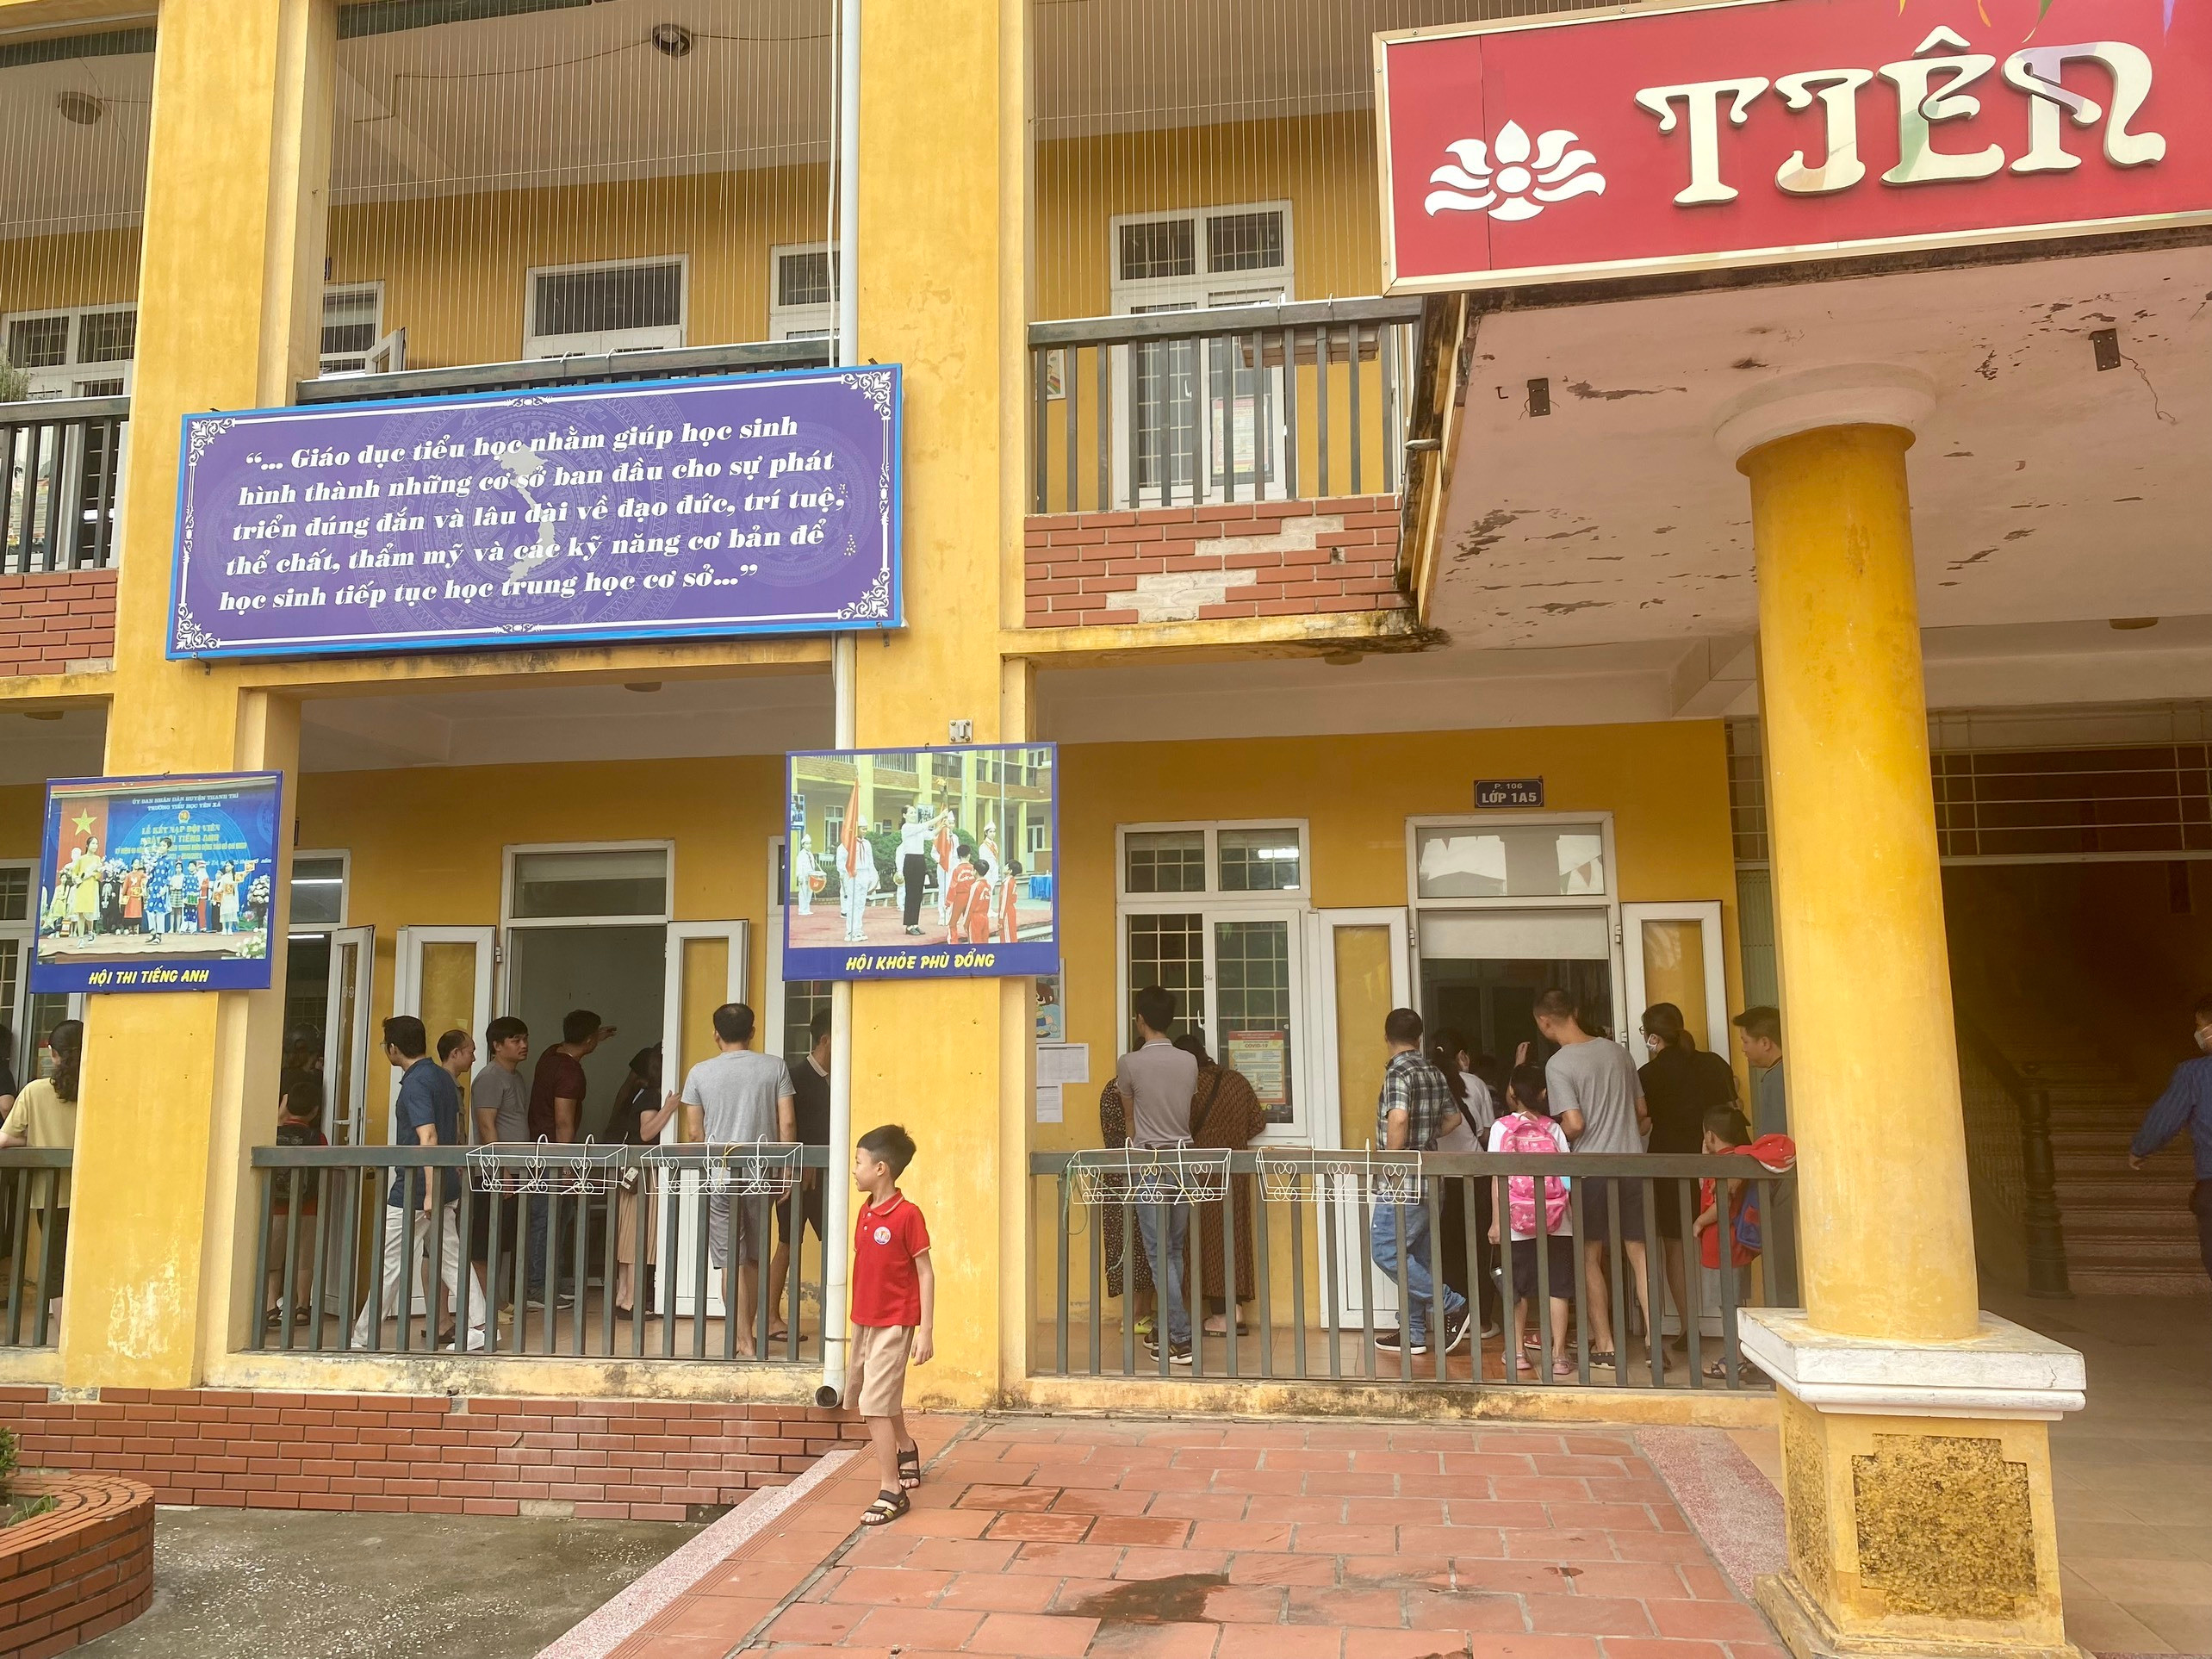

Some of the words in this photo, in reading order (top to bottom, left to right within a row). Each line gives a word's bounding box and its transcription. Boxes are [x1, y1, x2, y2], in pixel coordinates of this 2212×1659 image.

[291, 446, 351, 469] Giáo
[357, 444, 405, 468] dục
[413, 434, 464, 460] tiểu
[473, 437, 522, 460] học
[530, 426, 605, 452] nhằm
[612, 424, 673, 451] giúp
[680, 422, 732, 447] học
[739, 416, 798, 439] sinh
[238, 484, 296, 506] hình
[304, 480, 380, 502] thành
[388, 474, 473, 497] những
[478, 472, 511, 492] cơ
[517, 466, 547, 488] sở
[553, 467, 603, 486] ban
[612, 457, 662, 482] đầu
[672, 458, 721, 479] cho
[729, 455, 763, 481] sự
[768, 449, 835, 478] phát
[233, 514, 296, 541] triển
[305, 515, 370, 538] đúng
[376, 506, 425, 532] đắn
[434, 508, 464, 529] và
[473, 506, 517, 527] lâu
[525, 501, 569, 524] dài
[576, 495, 609, 520] về
[618, 498, 668, 523] đạo
[676, 493, 736, 517] đức,
[744, 488, 781, 511] trí
[788, 487, 845, 513] tuệ,
[226, 550, 270, 576] thể
[276, 548, 341, 575] chất,
[349, 543, 414, 569] thẩm
[422, 544, 464, 569] mỹ
[473, 541, 504, 562] và
[513, 537, 560, 560] các
[567, 535, 603, 562] kỹ
[611, 532, 681, 557] năng
[688, 531, 722, 550] cơ
[727, 525, 781, 549] bản
[790, 518, 827, 545] để
[218, 592, 267, 616] học
[272, 587, 326, 609] sinh
[335, 581, 387, 608] tiếp
[394, 584, 438, 606] tục
[444, 580, 494, 604] học
[501, 575, 578, 599] trung
[583, 572, 636, 597] học
[643, 570, 677, 589] cơ
[1482, 789, 1507, 803] LỚP
[1511, 792, 1537, 803] 1A5
[88, 969, 113, 987] HỘI
[116, 971, 138, 984] THI
[141, 965, 178, 984] TIẾNG
[180, 969, 209, 982] ANH
[846, 953, 873, 972] HỘI
[875, 951, 916, 971] KHỎE
[920, 951, 950, 969] PHÙ
[954, 948, 995, 968] ĐỔNG
